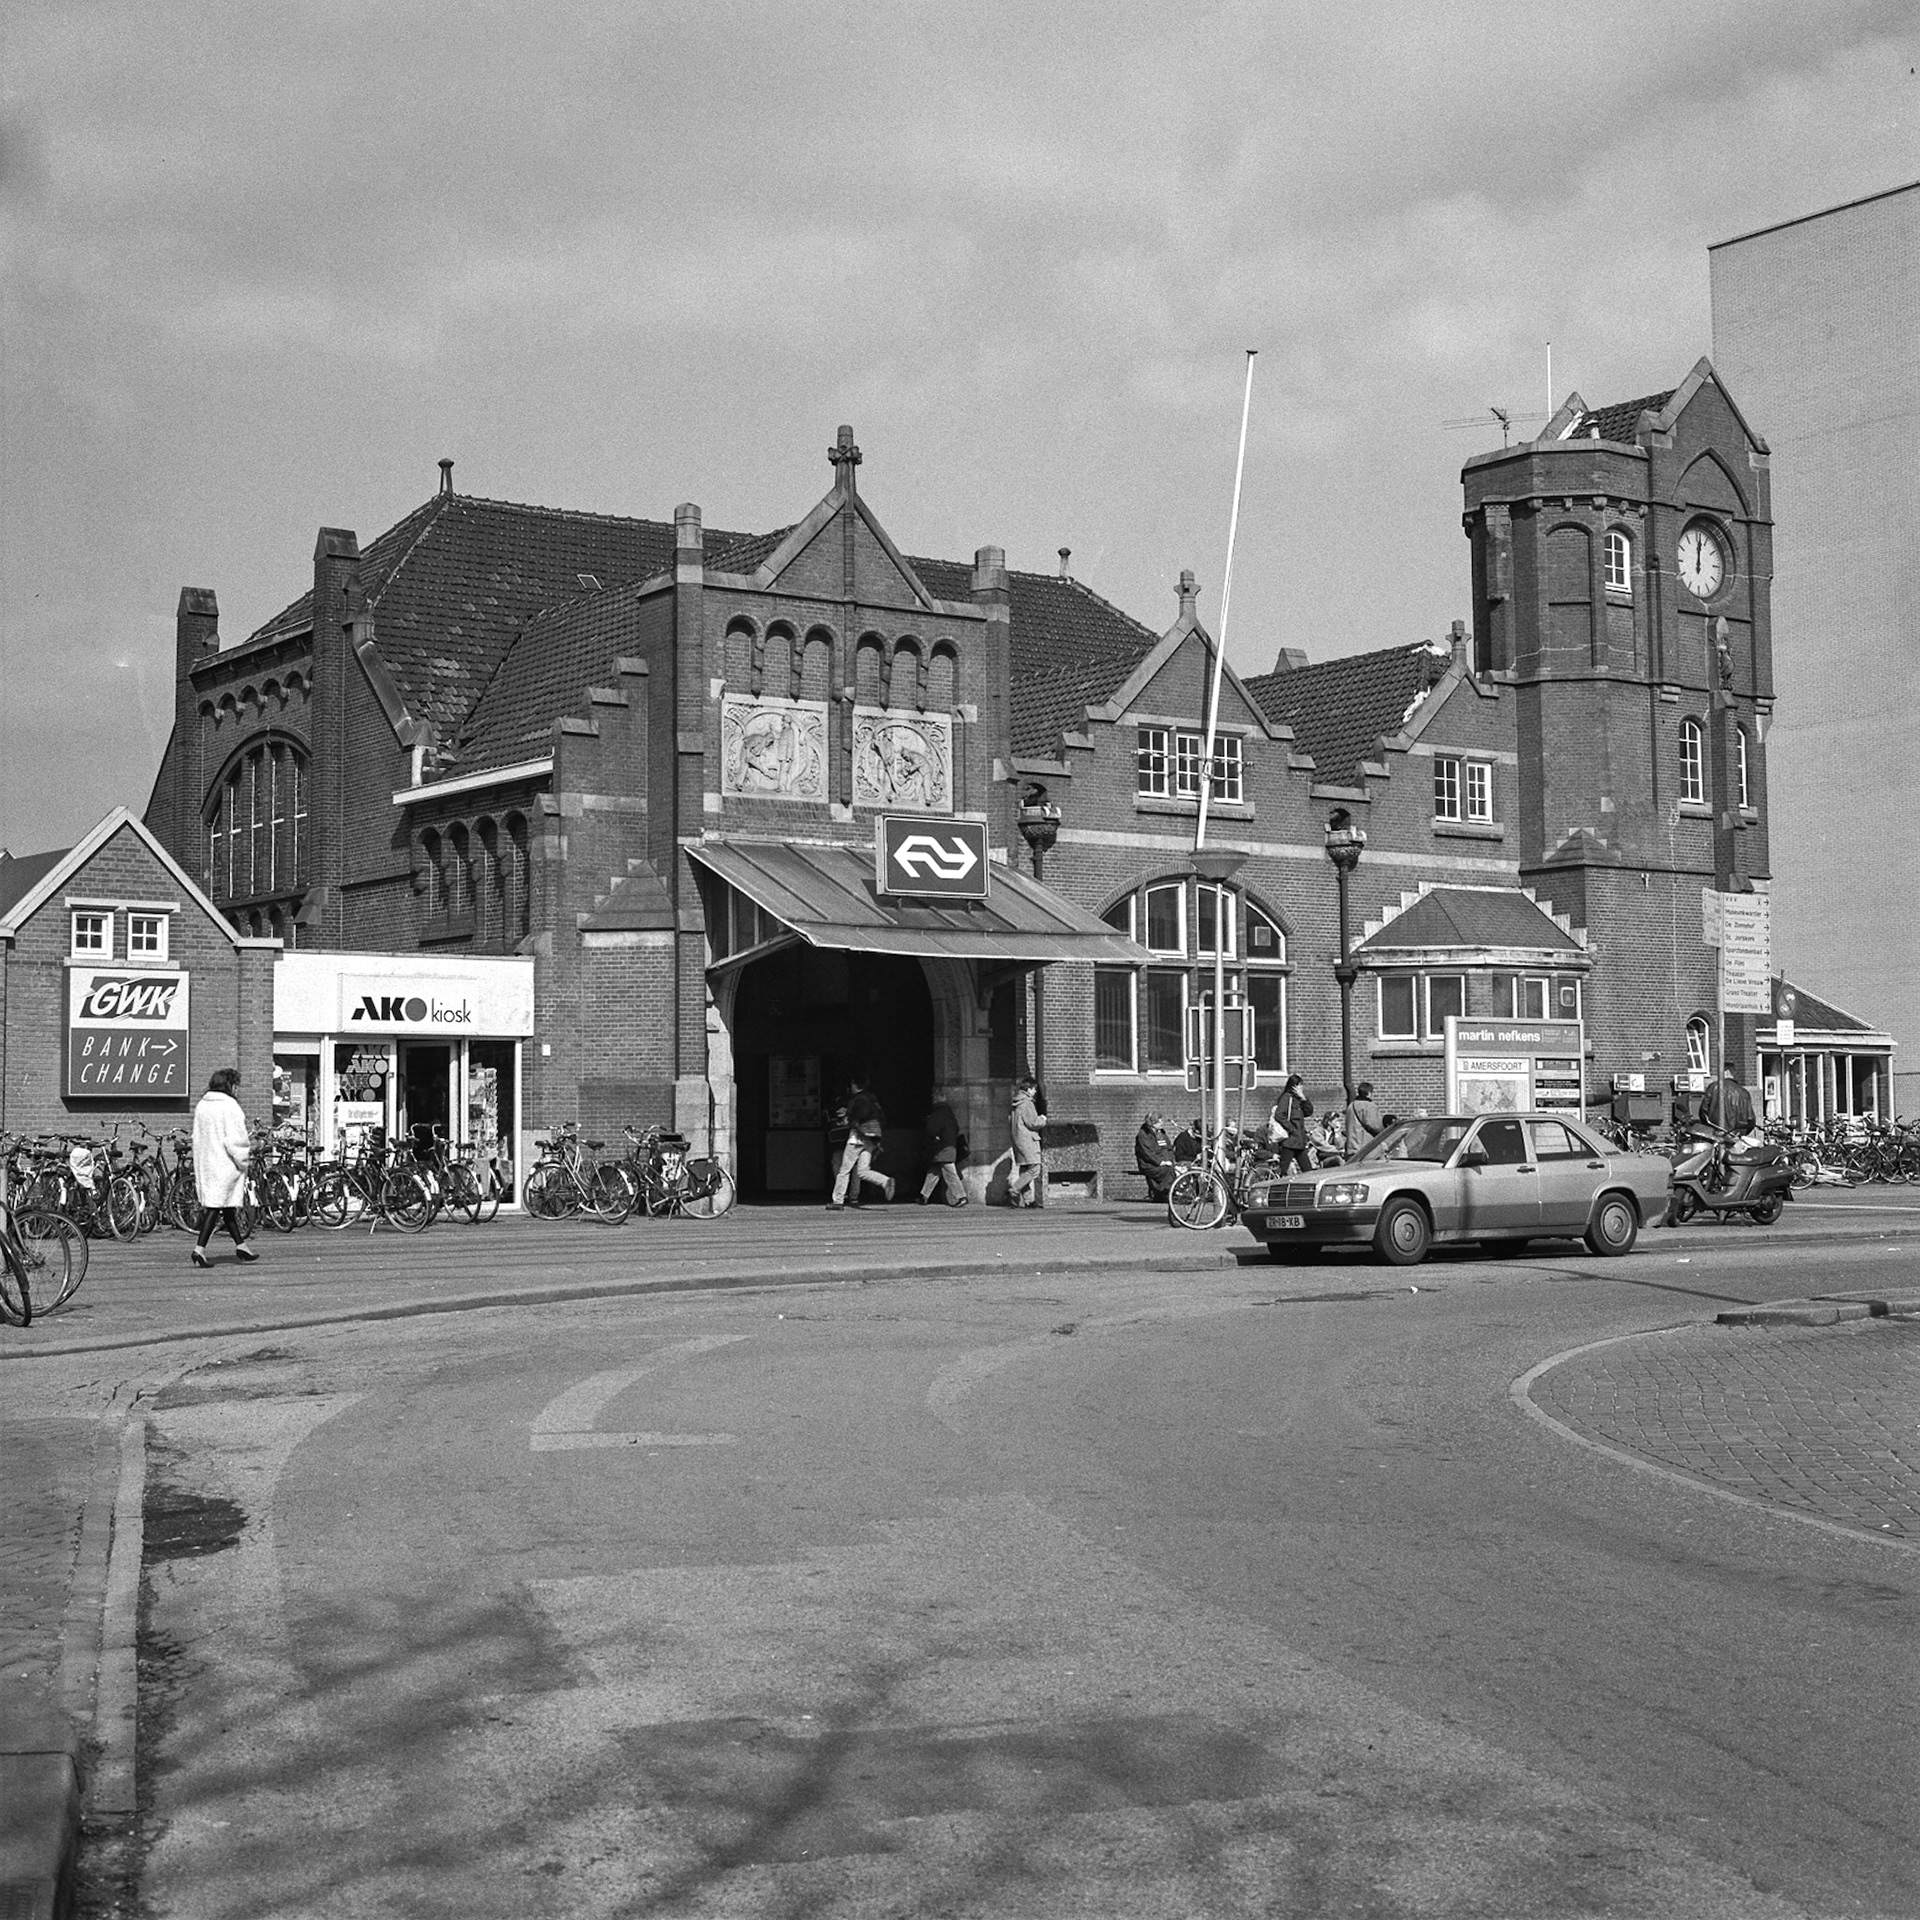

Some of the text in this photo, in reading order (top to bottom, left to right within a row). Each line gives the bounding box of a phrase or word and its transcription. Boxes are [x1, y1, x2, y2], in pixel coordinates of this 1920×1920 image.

[90, 981, 176, 1016] GWK
[1725, 988, 1758, 997] Grand Theater
[351, 996, 471, 1023] AKO kiosk
[1458, 1029, 1495, 1041] martin
[1498, 1029, 1541, 1042] nefkens
[81, 1036, 151, 1057] BANK
[80, 1062, 176, 1084] CHANGE
[345, 1059, 388, 1074] AKO
[1471, 1061, 1523, 1071] AMERSFOORT
[339, 1073, 382, 1089] AKO
[334, 1088, 376, 1102] AKO
